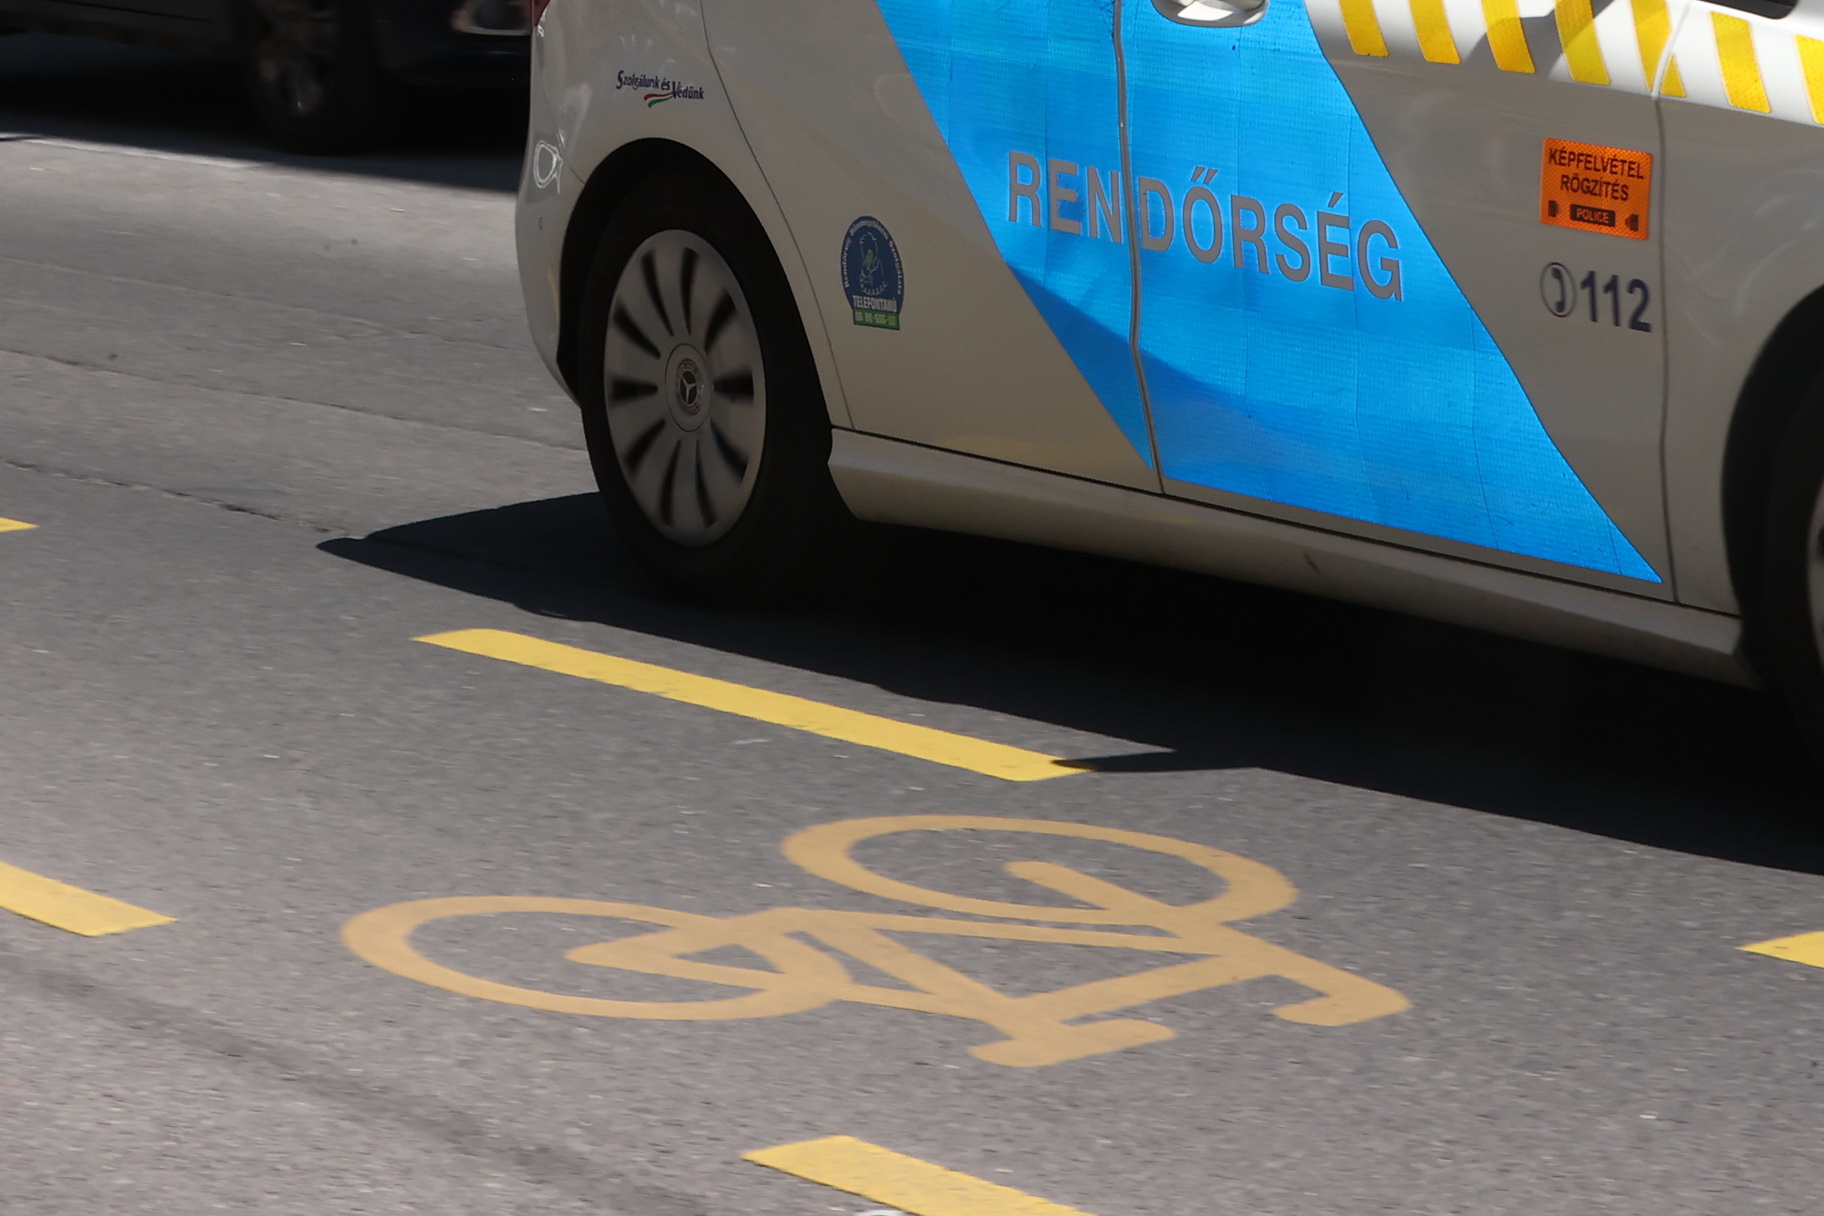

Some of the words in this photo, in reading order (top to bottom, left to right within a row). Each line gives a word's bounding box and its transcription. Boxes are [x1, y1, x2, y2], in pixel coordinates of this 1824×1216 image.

[661, 78, 671, 91] és
[1548, 145, 1645, 179] KÉPFELVÉTEL
[1560, 173, 1630, 201] RÖGZÍTÉS
[1007, 151, 1402, 302] RENDŐRSÉG
[1576, 208, 1610, 223] POLICE
[1580, 270, 1652, 333] 112
